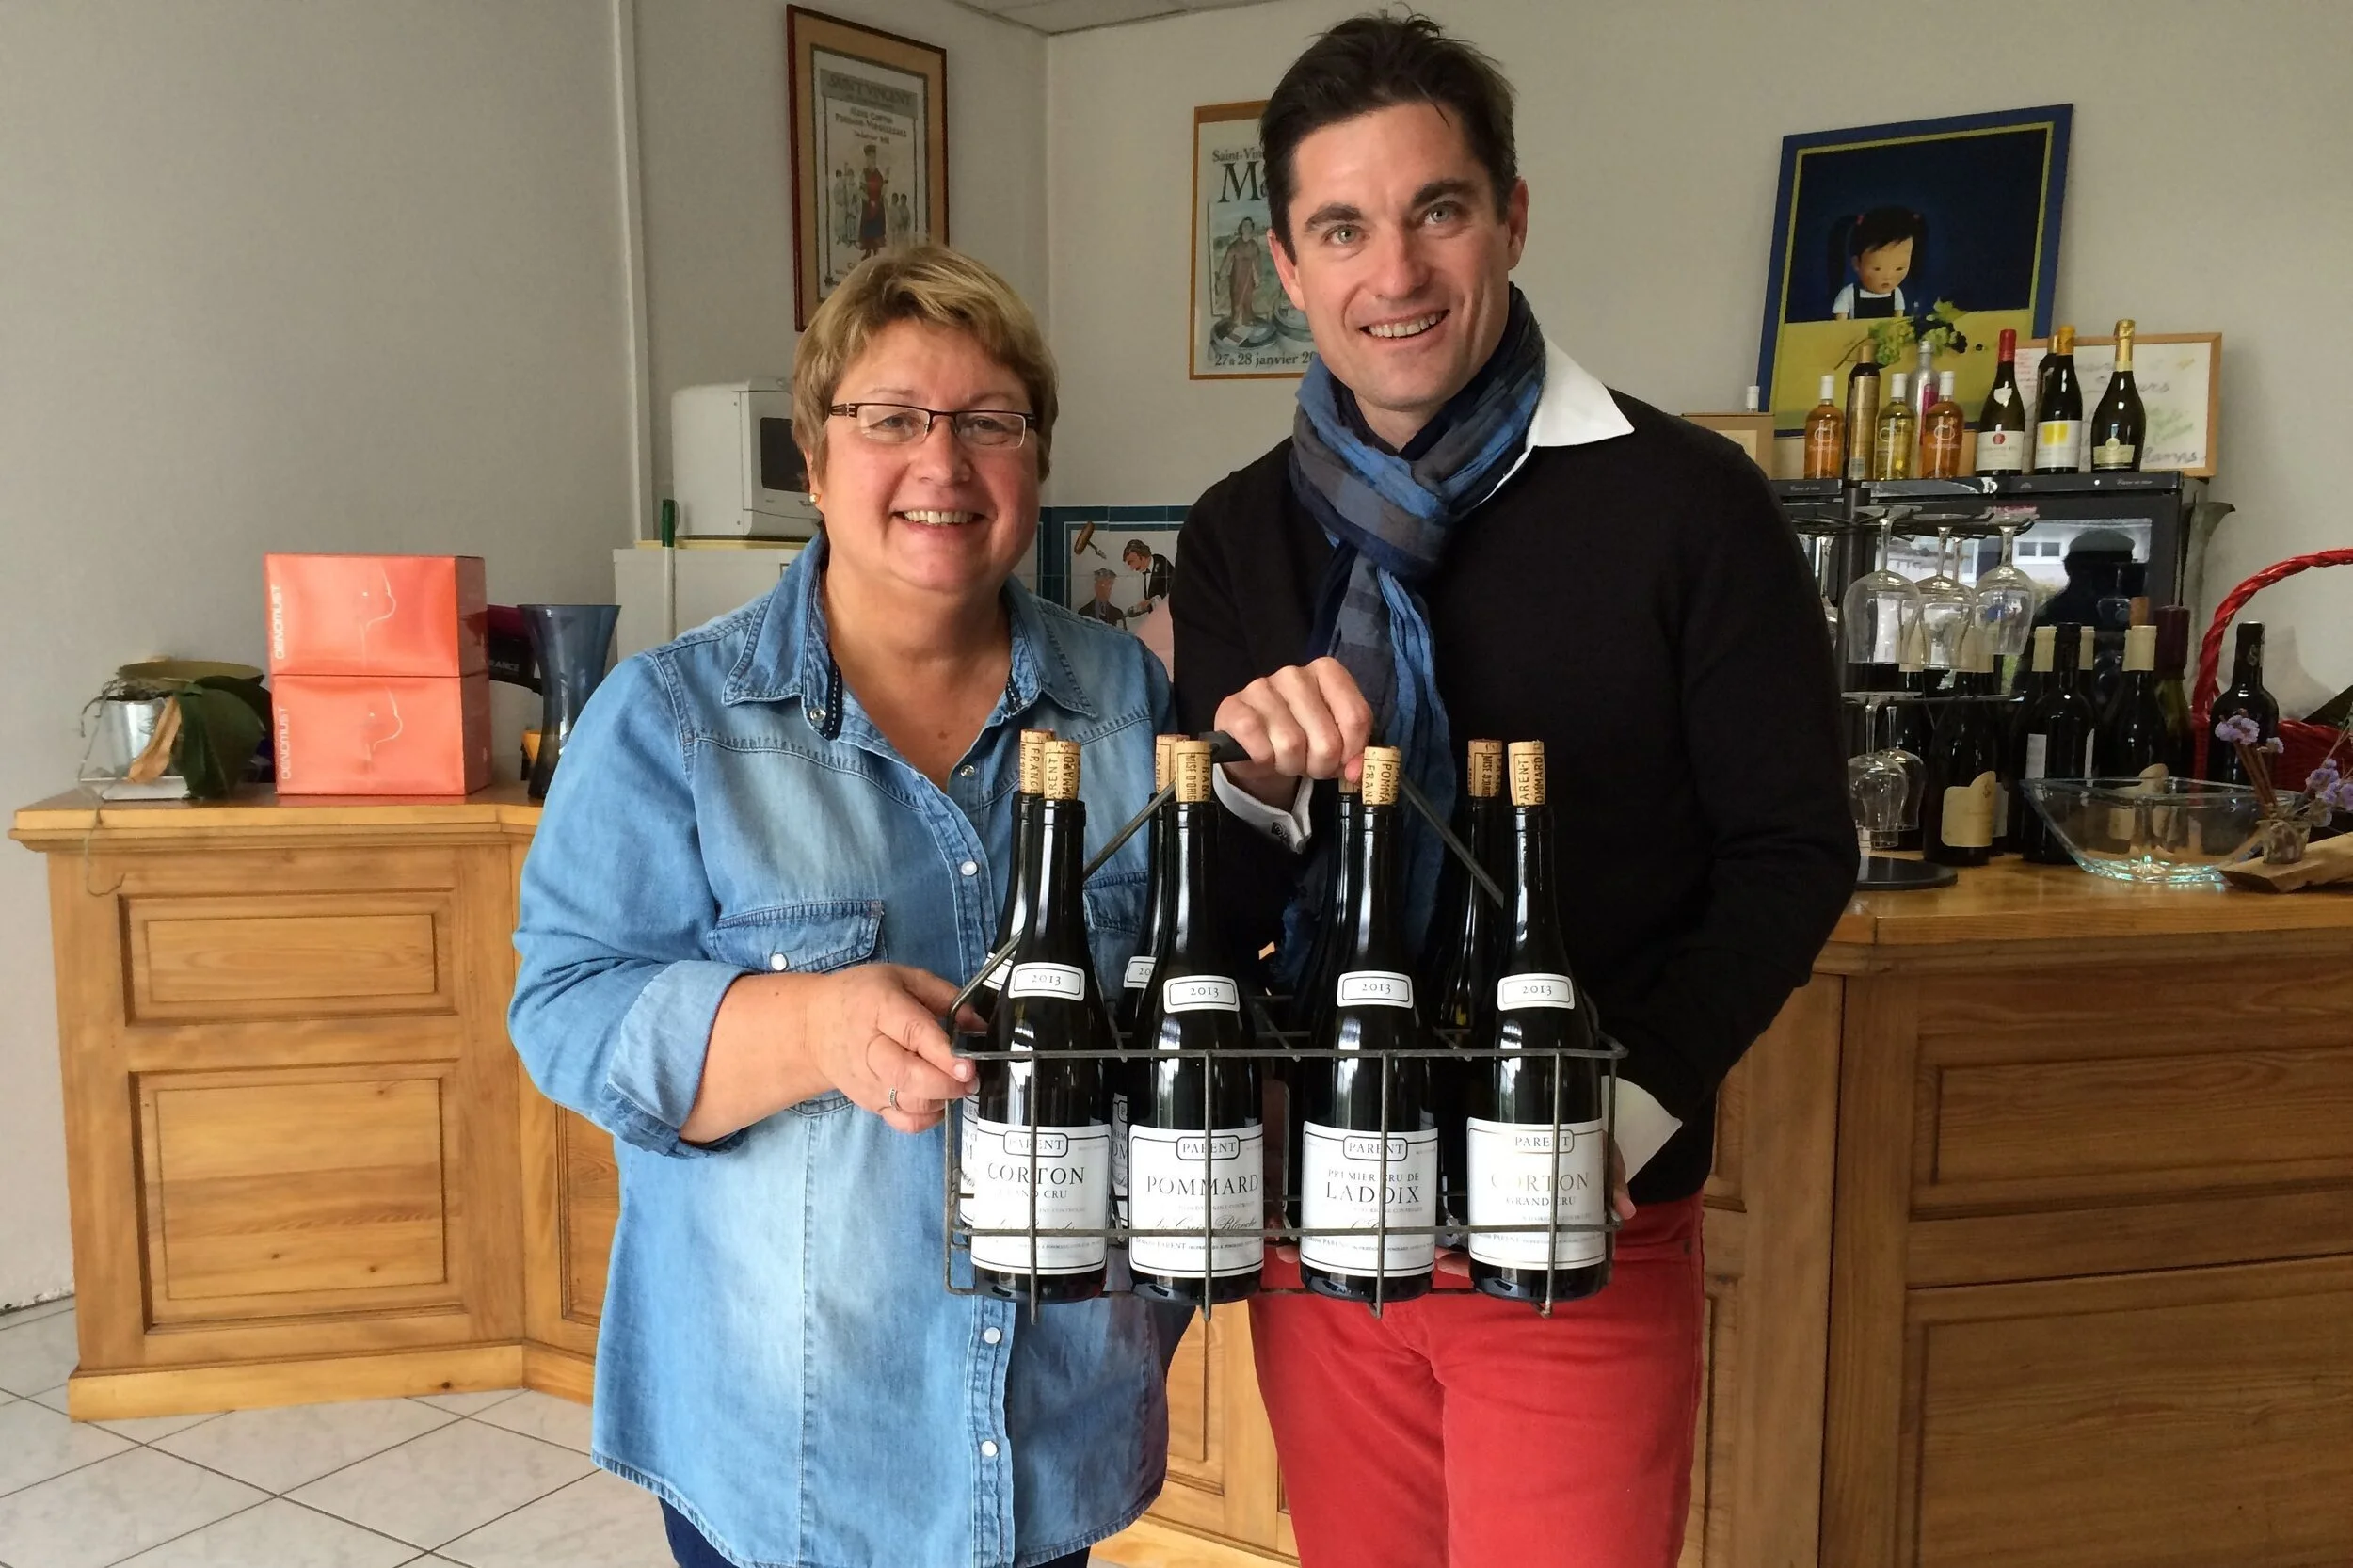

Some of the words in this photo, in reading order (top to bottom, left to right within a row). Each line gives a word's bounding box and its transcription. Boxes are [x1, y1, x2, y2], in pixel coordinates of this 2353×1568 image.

[1215, 353, 1230, 366] 27
[1238, 352, 1253, 365] 28
[1256, 351, 1298, 368] janvier
[1032, 973, 1061, 986] 2013
[1190, 986, 1219, 998] 2013
[1362, 983, 1391, 994] 2013
[1522, 984, 1552, 996] 2013
[1515, 1135, 1570, 1147] PARET
[988, 1162, 1085, 1185] CORTON
[1328, 1169, 1375, 1182] PREMIER
[1407, 1172, 1419, 1182] DE
[1147, 1174, 1259, 1196] POMMARD
[1043, 1190, 1067, 1199] CRU
[1326, 1181, 1420, 1204] LADOIX
[1506, 1197, 1550, 1207] GRAND
